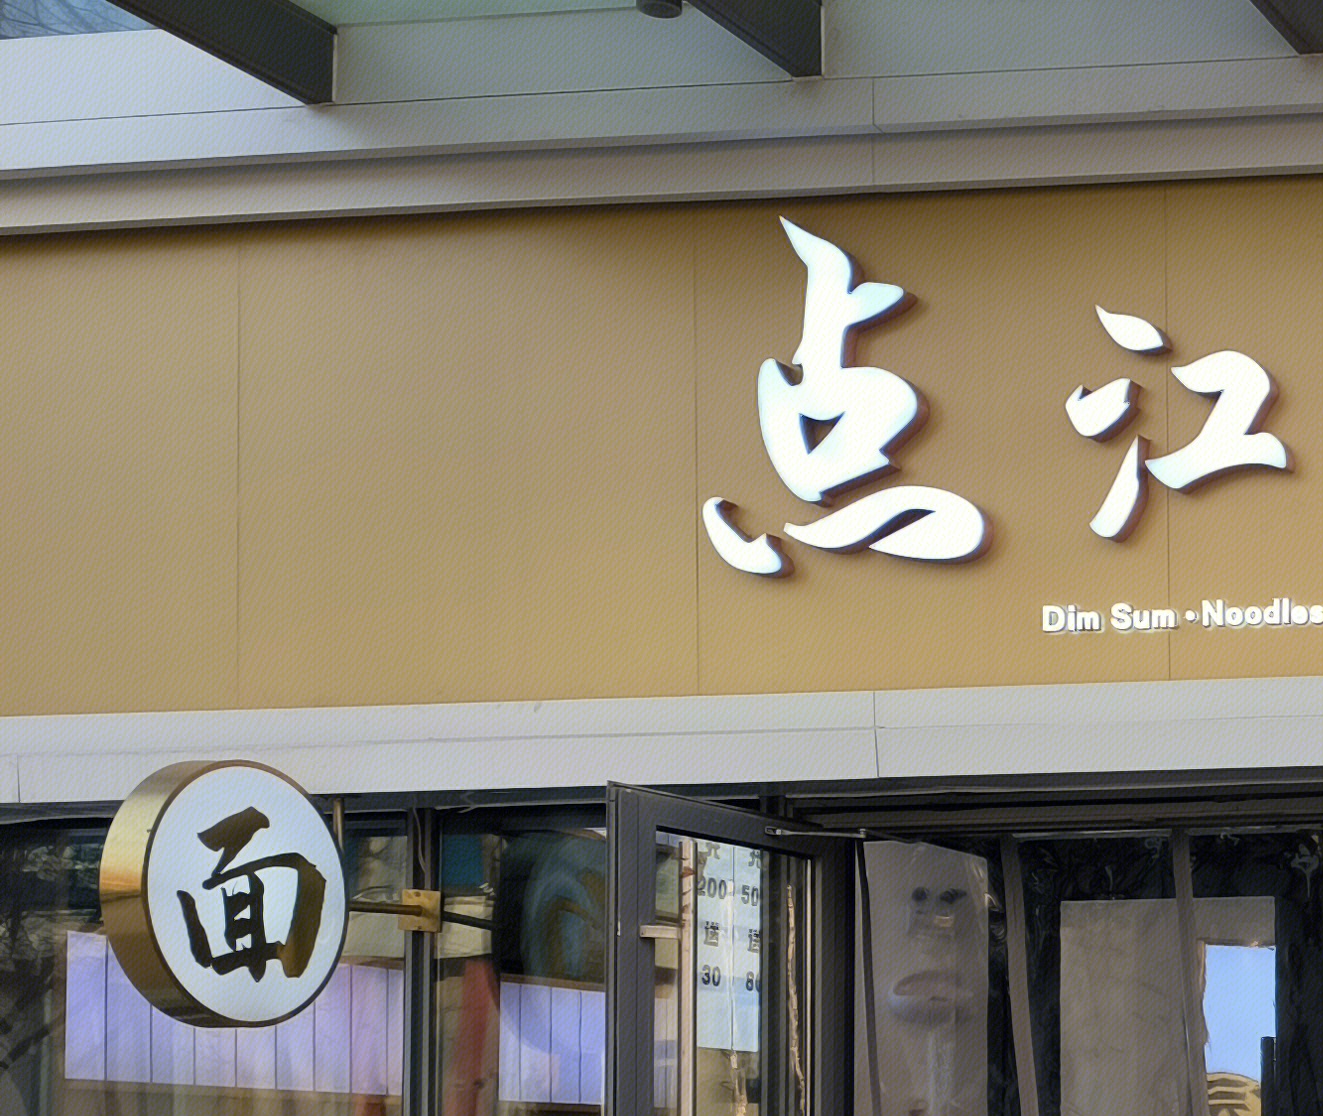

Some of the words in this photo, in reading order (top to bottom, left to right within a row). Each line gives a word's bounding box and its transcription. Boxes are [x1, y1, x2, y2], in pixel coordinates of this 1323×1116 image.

[1042, 604, 1102, 633] Dim
[1110, 602, 1176, 631] Sum
[176, 806, 328, 982] 面
